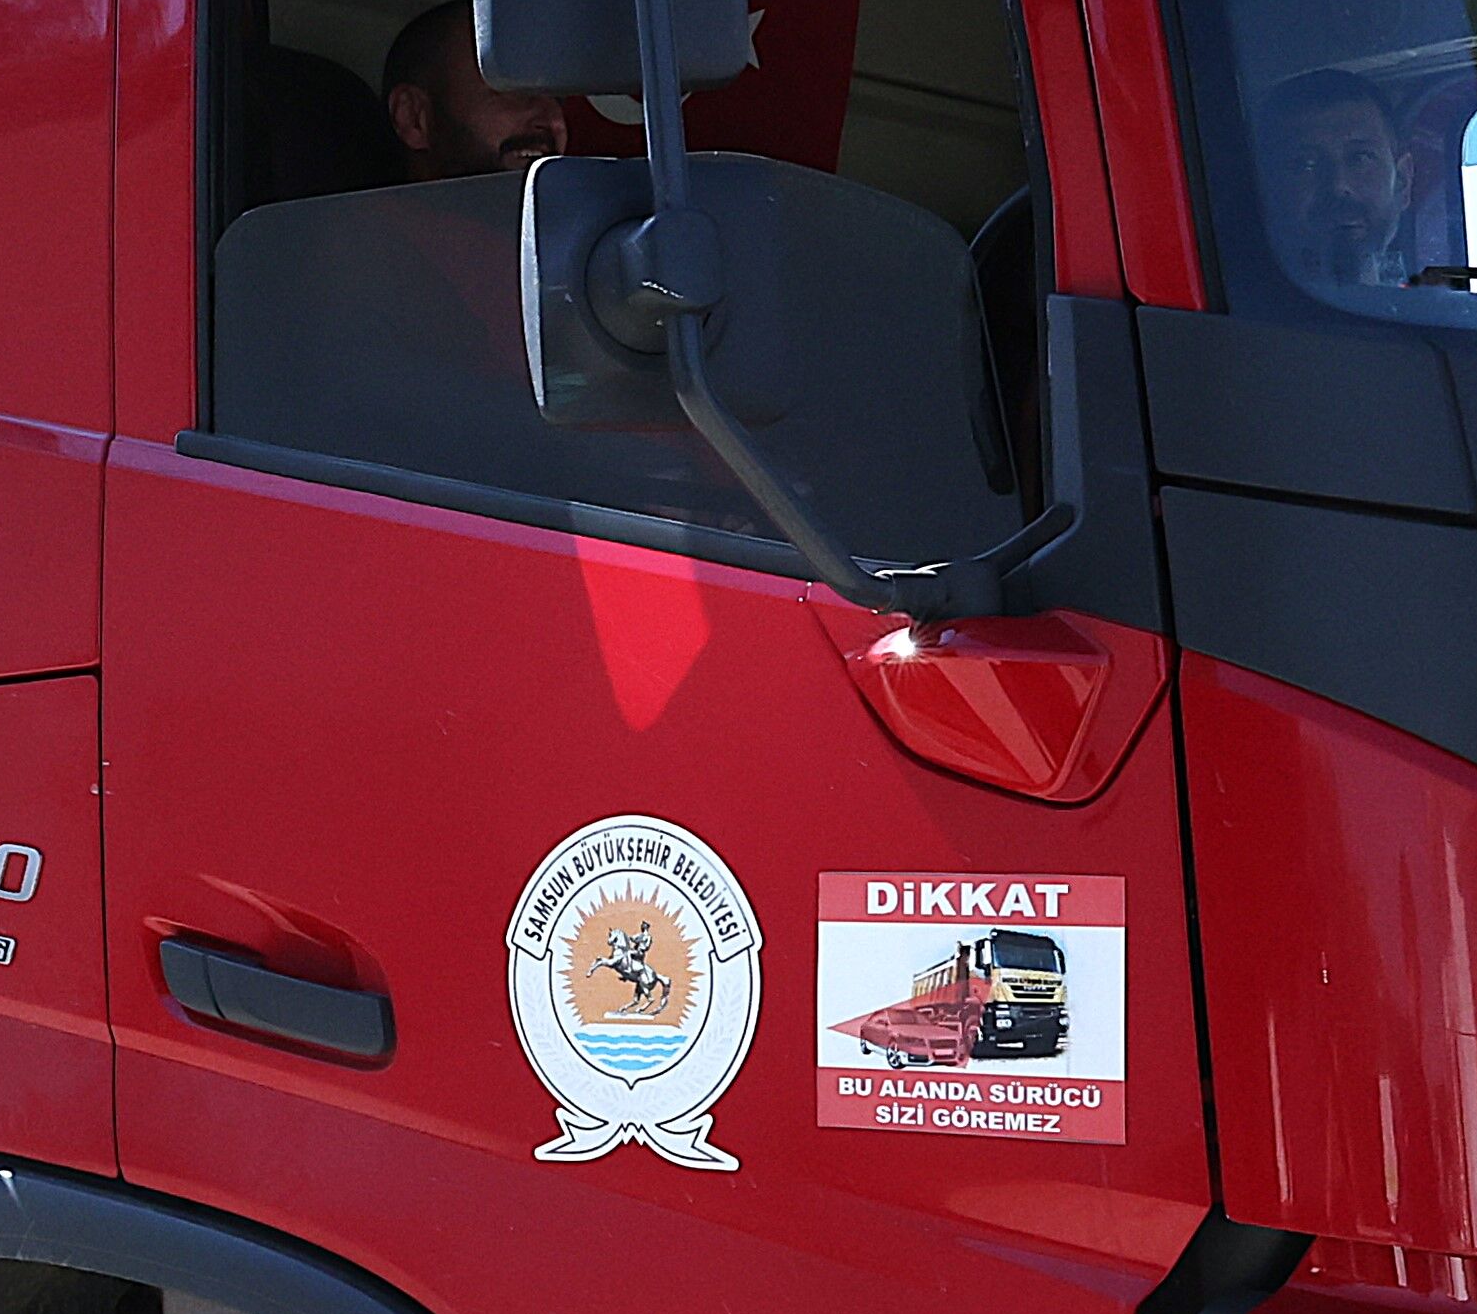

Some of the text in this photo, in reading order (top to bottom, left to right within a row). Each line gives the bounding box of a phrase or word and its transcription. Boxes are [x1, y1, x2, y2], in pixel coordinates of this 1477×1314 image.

[524, 833, 746, 943] SAMSUN BÜYÜKŞEHİR BELEDİYESİ
[838, 1076, 1102, 1108] BU ALANDA SÜRÜCÜ
[875, 1102, 1061, 1134] SİZİ GÖREMEZ
